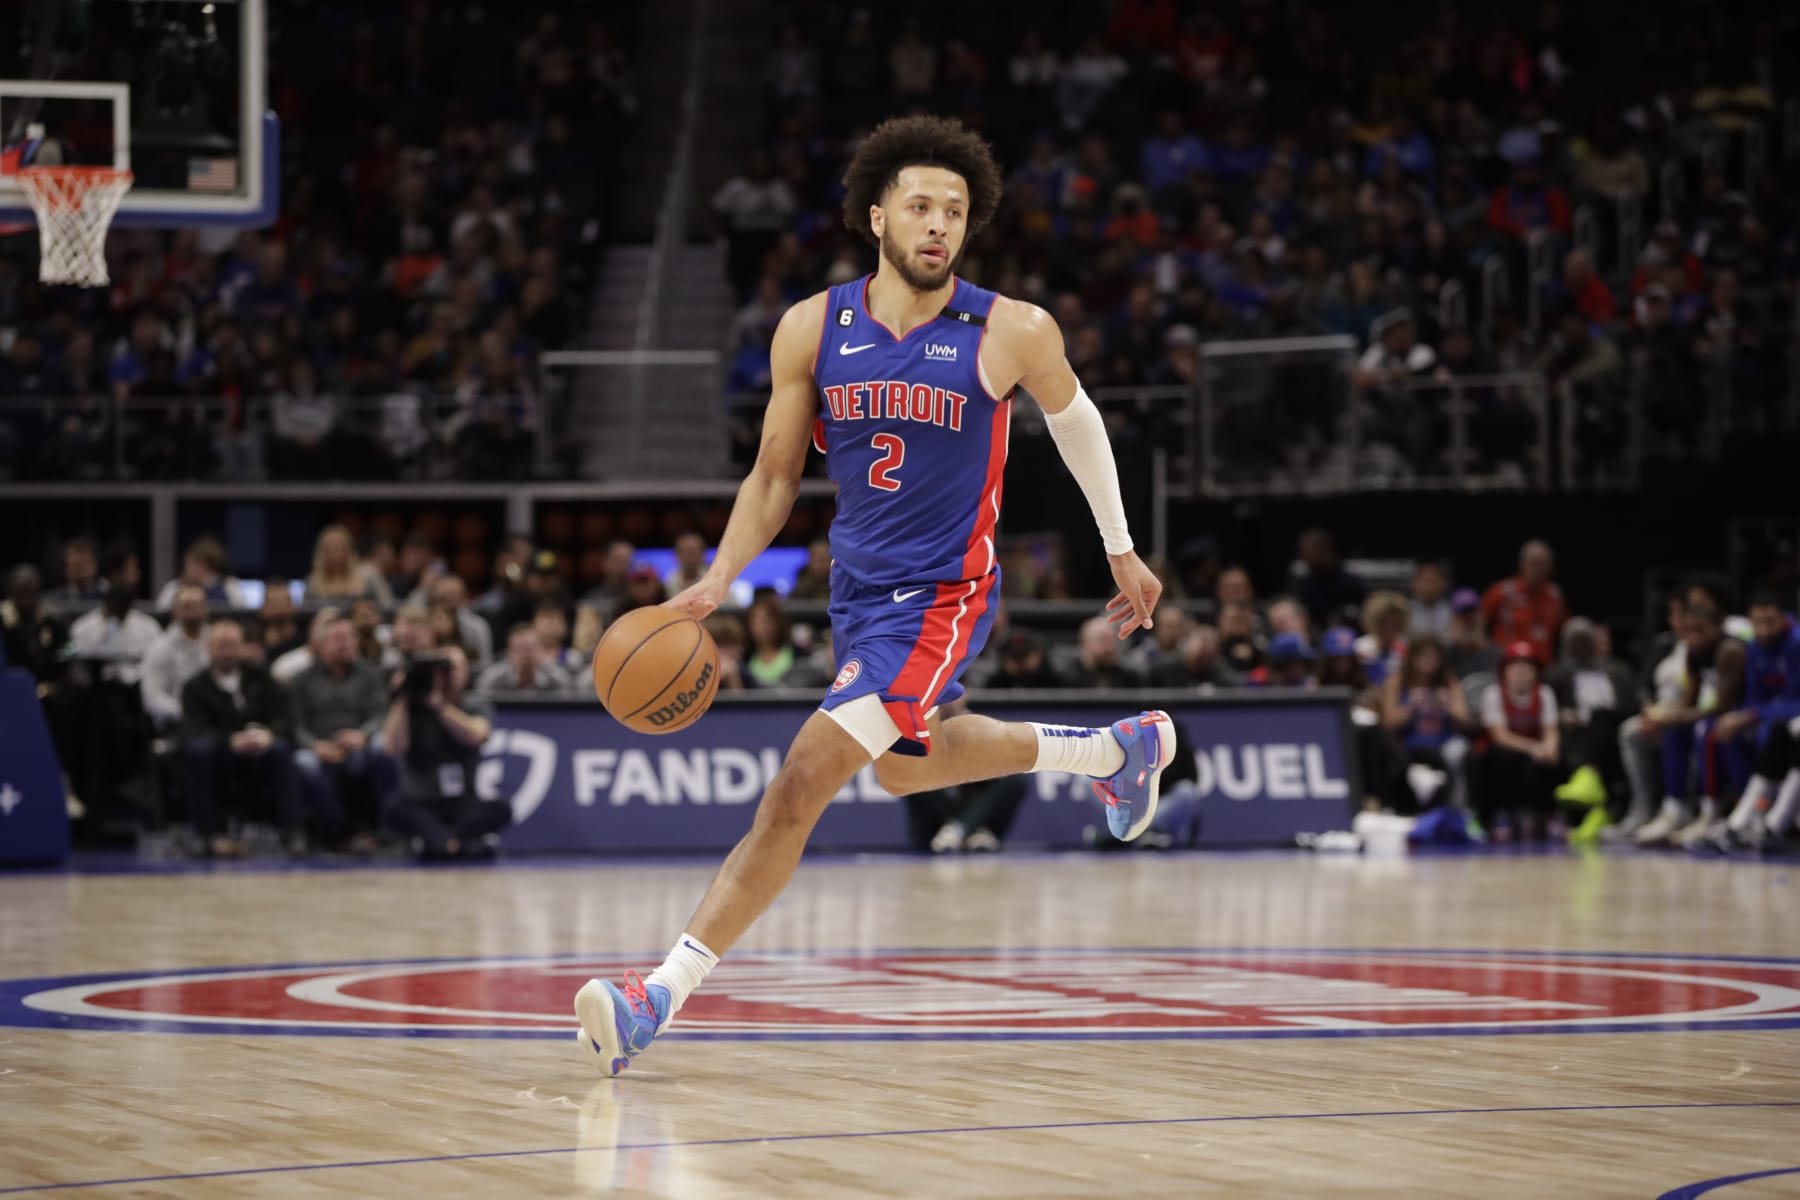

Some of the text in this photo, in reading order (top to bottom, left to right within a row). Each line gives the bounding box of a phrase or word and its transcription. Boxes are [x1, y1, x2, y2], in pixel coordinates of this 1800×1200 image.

[839, 309, 853, 326] 6
[925, 343, 957, 357] UWM
[824, 380, 967, 432] DETROIT
[868, 432, 905, 492] 2
[645, 662, 713, 726] Wilson
[573, 747, 899, 805] FANDL
